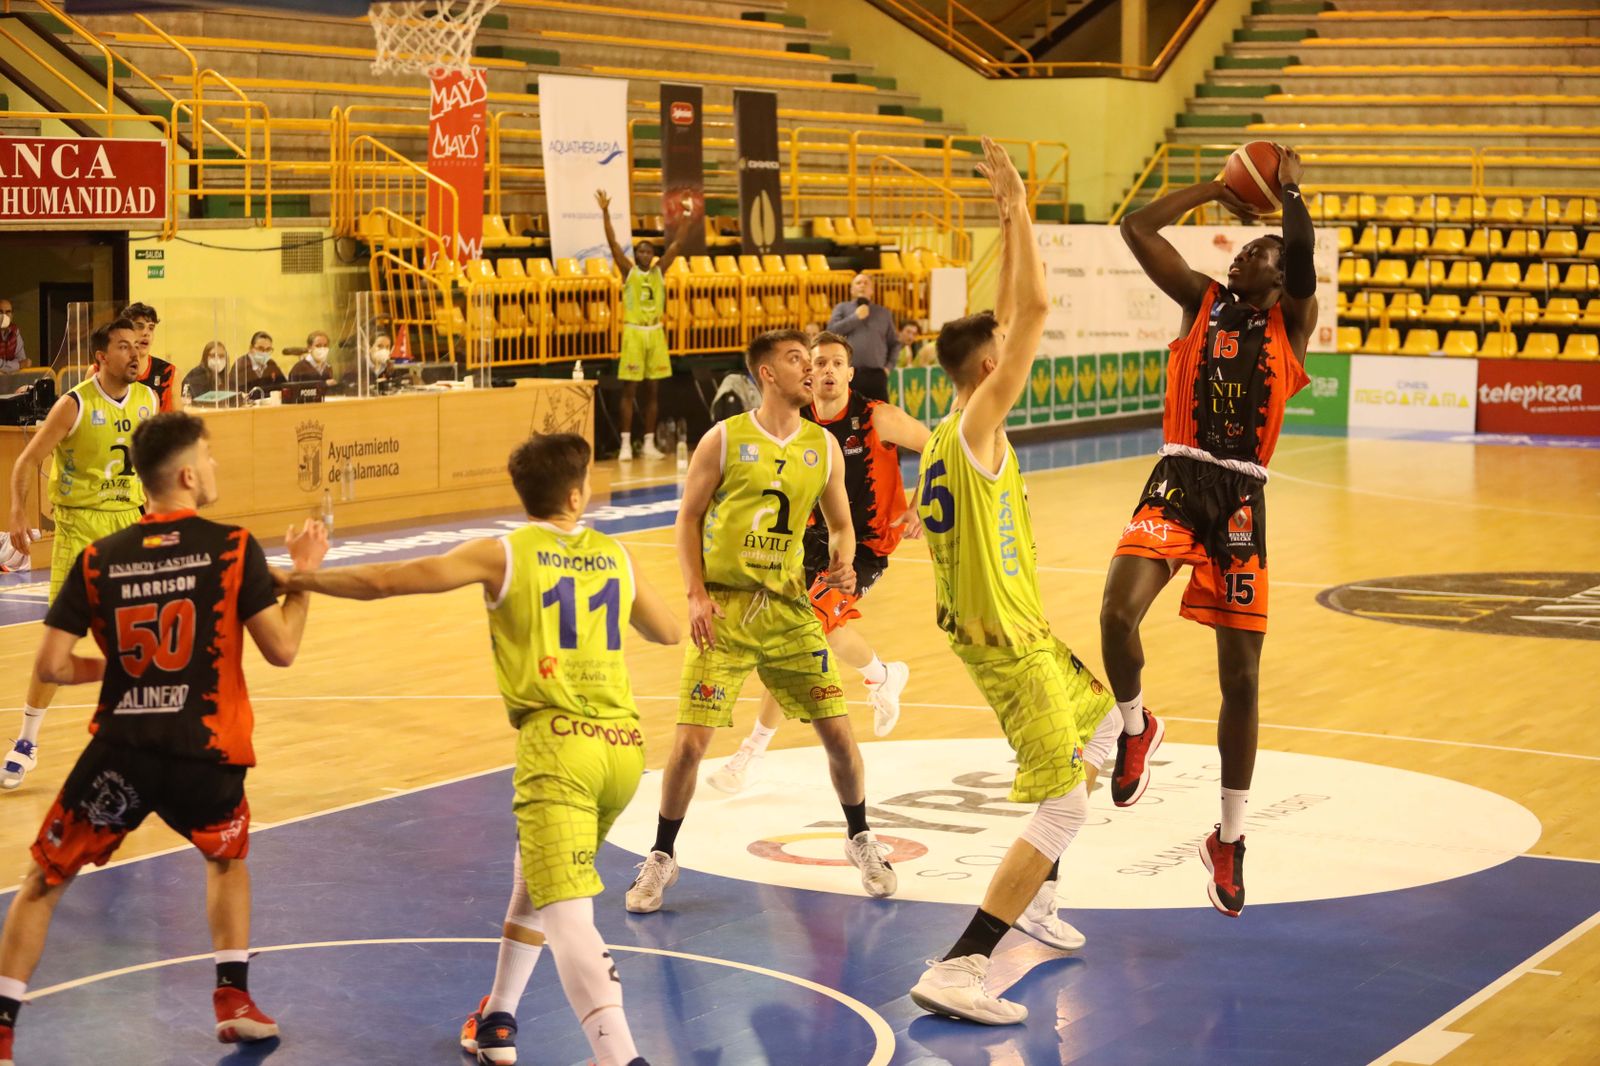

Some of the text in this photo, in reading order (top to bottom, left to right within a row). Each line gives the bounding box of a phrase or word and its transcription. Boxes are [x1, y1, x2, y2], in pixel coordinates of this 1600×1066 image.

[432, 122, 480, 159] MAYS
[549, 139, 620, 155] AQUATHERAPIA
[0, 143, 117, 179] NCA
[1, 186, 156, 215] HUMANIDAD
[145, 250, 163, 259] SALIDA
[1479, 381, 1582, 409] telepizza
[114, 419, 131, 432] 10
[328, 438, 399, 460] Ayuntamiento
[328, 463, 399, 483] de alamanca
[774, 459, 786, 475] 7
[999, 490, 1019, 577] CEVESA
[121, 574, 196, 600] HARRISON
[1225, 572, 1256, 606] 15
[542, 576, 621, 651] 11
[115, 598, 196, 678] 50
[812, 648, 829, 673] 7
[116, 684, 189, 708] ALINERO
